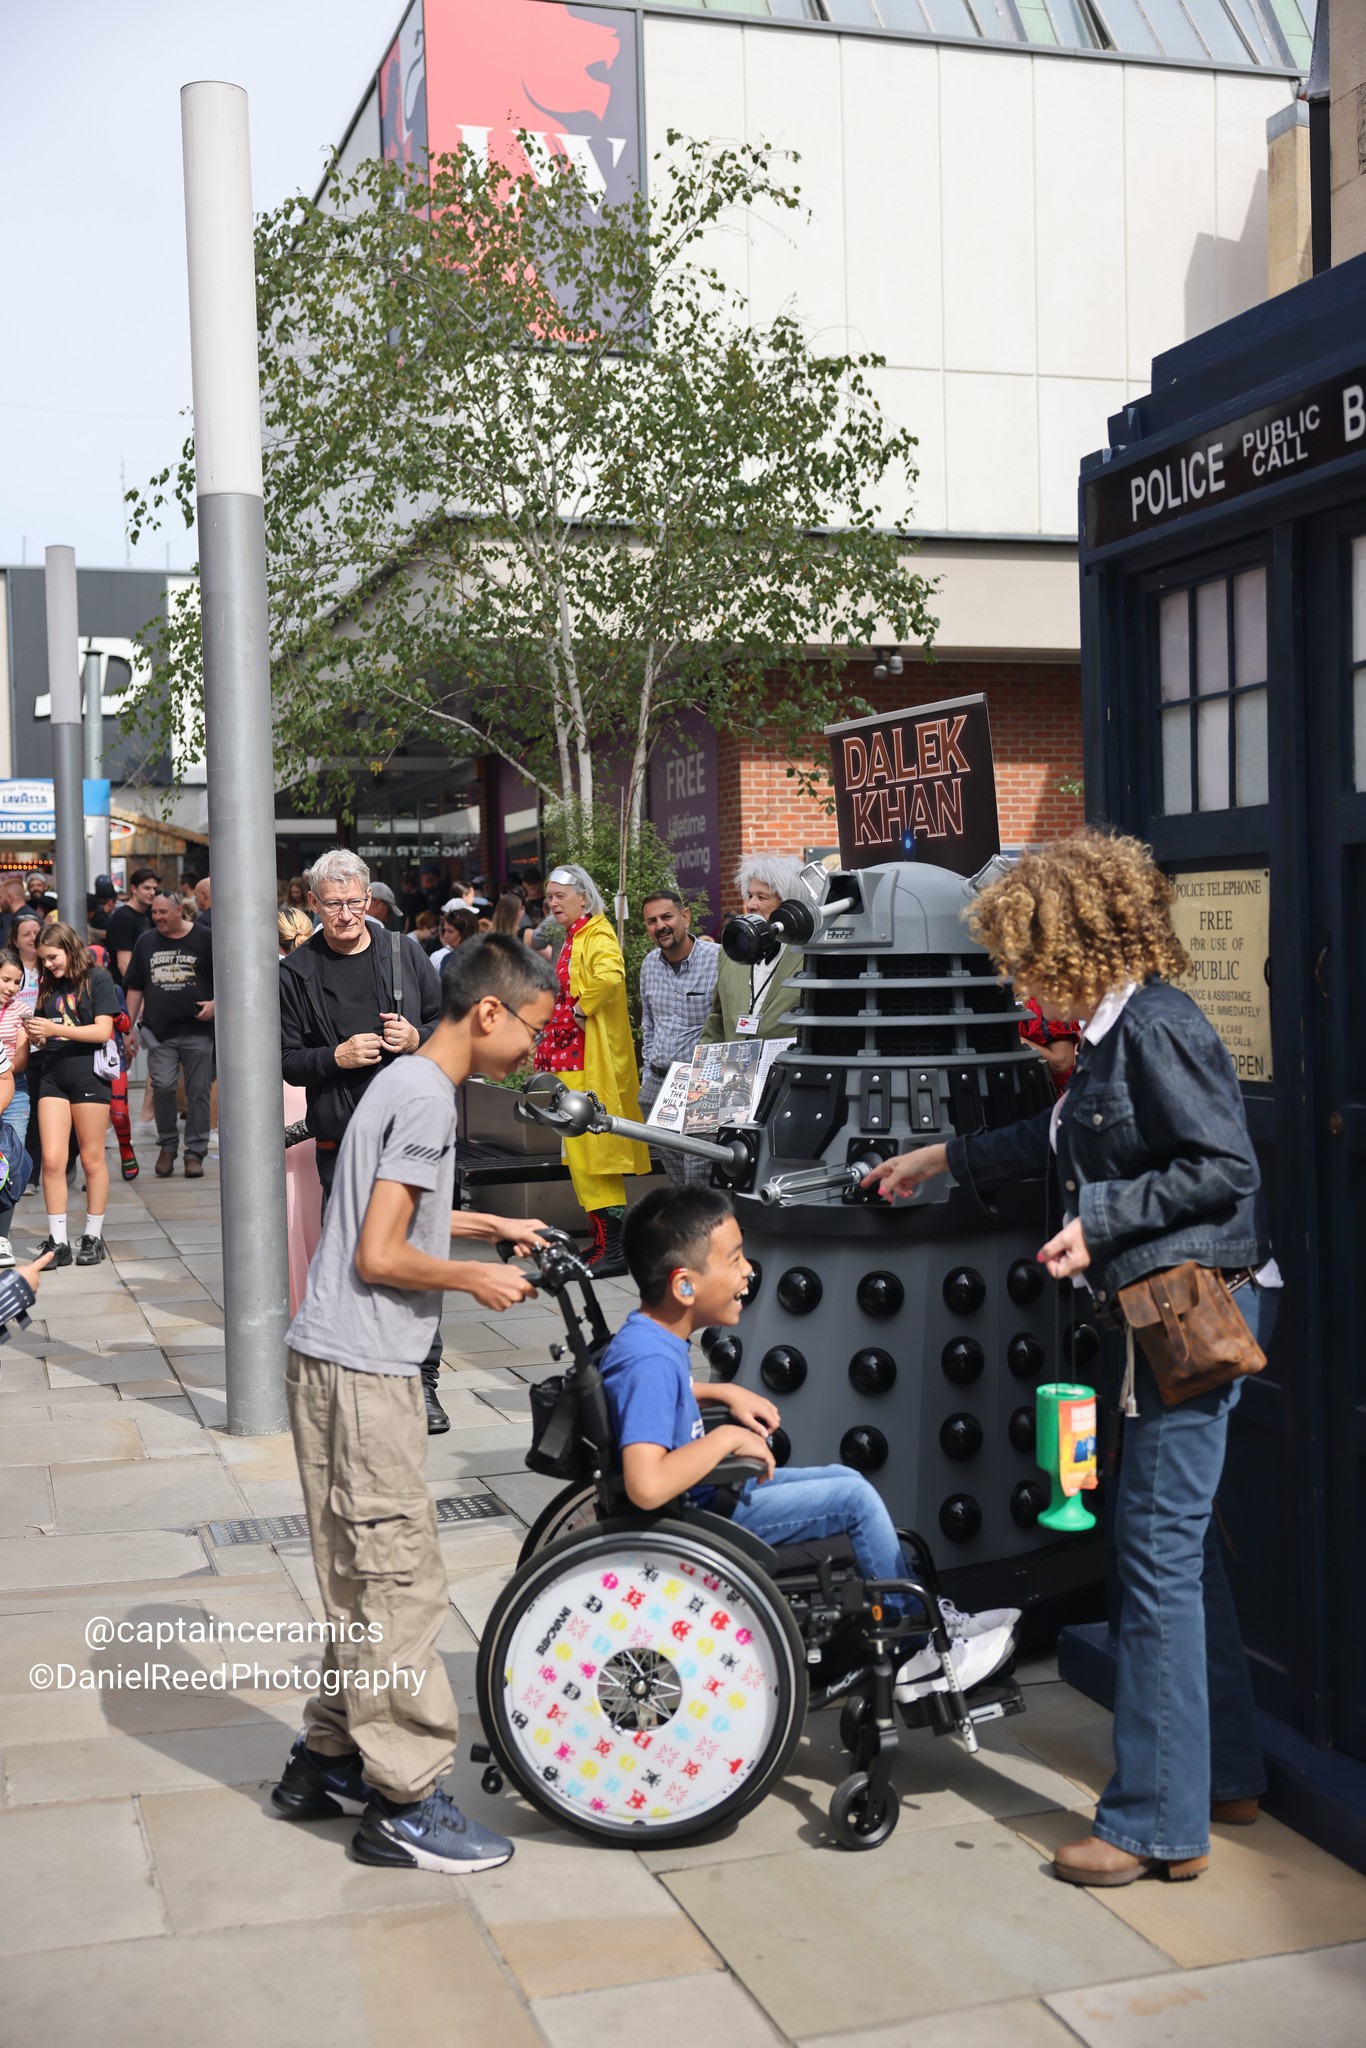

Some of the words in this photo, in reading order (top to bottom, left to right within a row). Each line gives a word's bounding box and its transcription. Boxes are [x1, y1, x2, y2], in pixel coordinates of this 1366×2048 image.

[1343, 384, 1366, 442] B
[1242, 404, 1321, 458] PUBLIC
[1252, 436, 1309, 477] CALL
[1131, 442, 1226, 523] POLICE
[842, 715, 971, 791] DALEK
[666, 752, 706, 802] FREE
[853, 778, 964, 846] KHAN
[1176, 882, 1205, 898] POLICE
[1206, 880, 1262, 896] TELEPHONE
[1199, 910, 1233, 931] FREE
[1190, 938, 1206, 951] FOR
[1211, 938, 1227, 950] USE
[1232, 937, 1244, 950] OF
[1193, 960, 1240, 981] PUBLIC
[1213, 991, 1252, 1002] ASSISTANCE
[1217, 1005, 1261, 1018] IMMEDIATELY
[1226, 1024, 1242, 1034] CARS
[1233, 1036, 1252, 1047] CALLS
